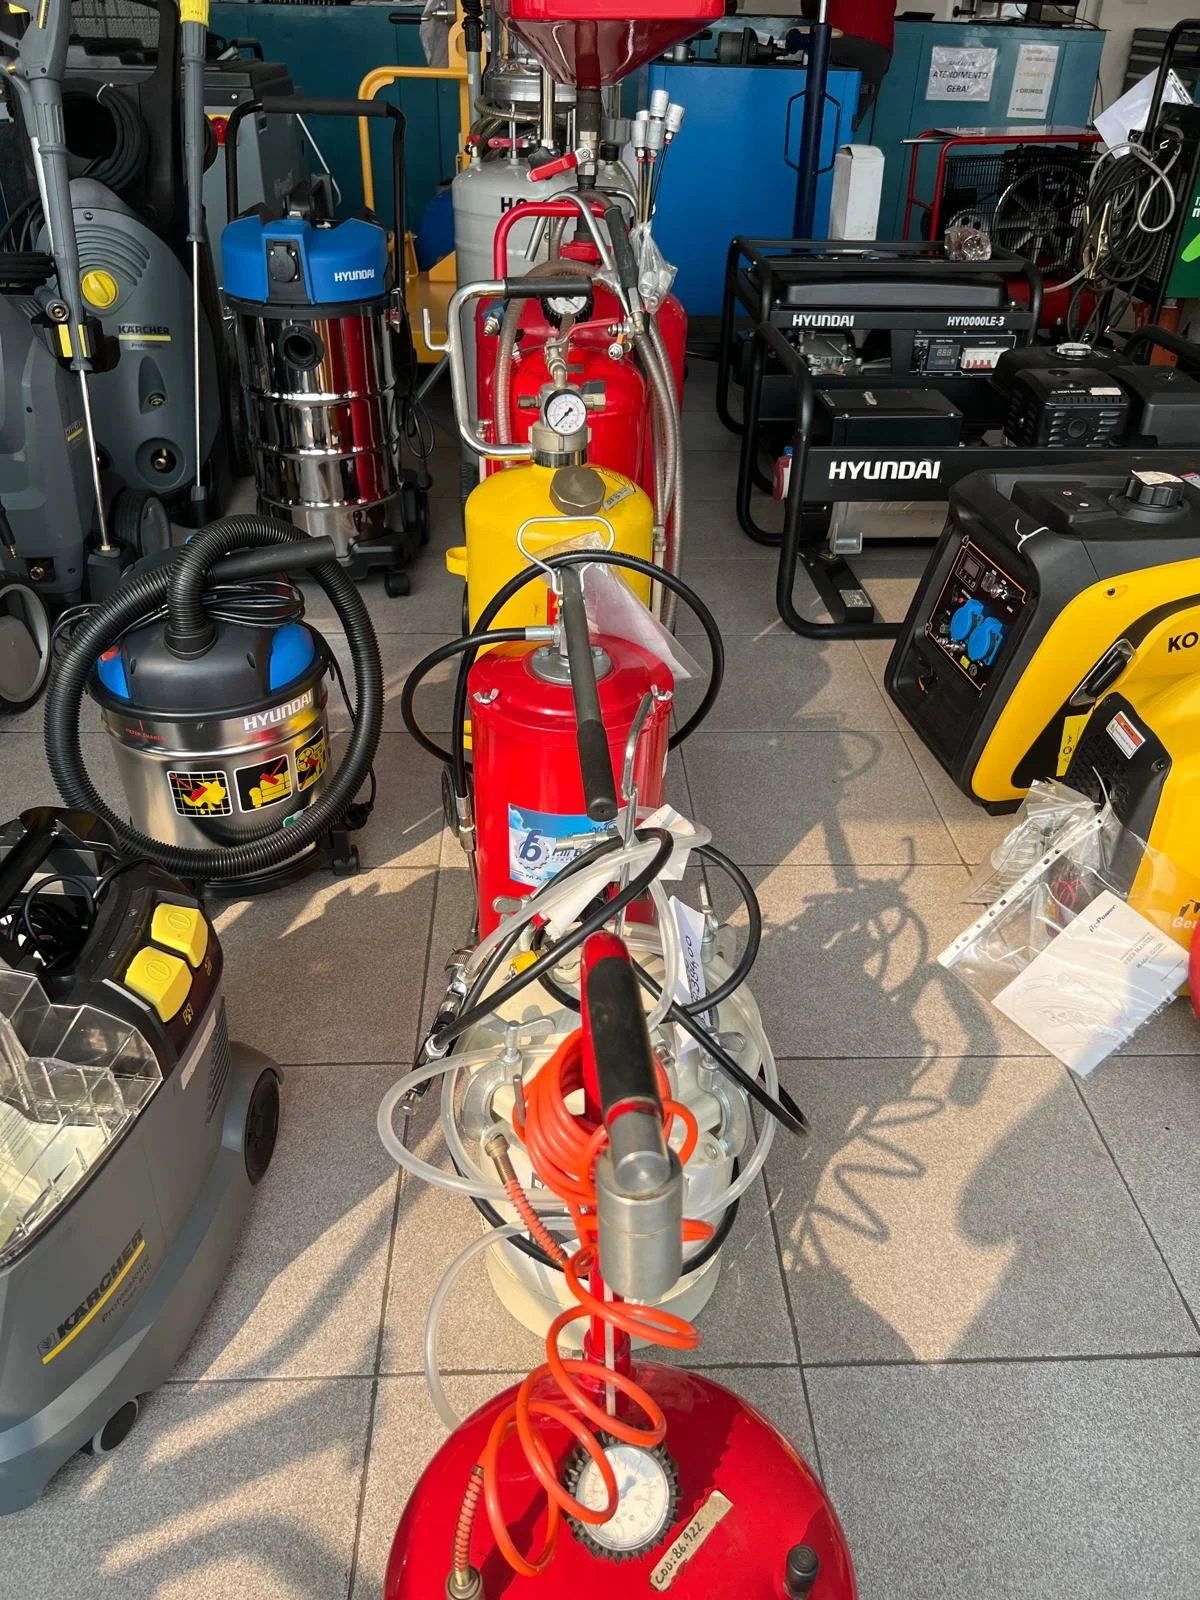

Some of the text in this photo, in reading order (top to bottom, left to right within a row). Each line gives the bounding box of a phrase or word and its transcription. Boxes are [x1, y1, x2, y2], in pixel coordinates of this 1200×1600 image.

[334, 269, 375, 282] HYUNDAI
[792, 314, 1005, 327] HYUNDAI HY10000LE-3
[828, 460, 941, 480] HYUNDAI
[243, 690, 313, 732] HYUNDAI
